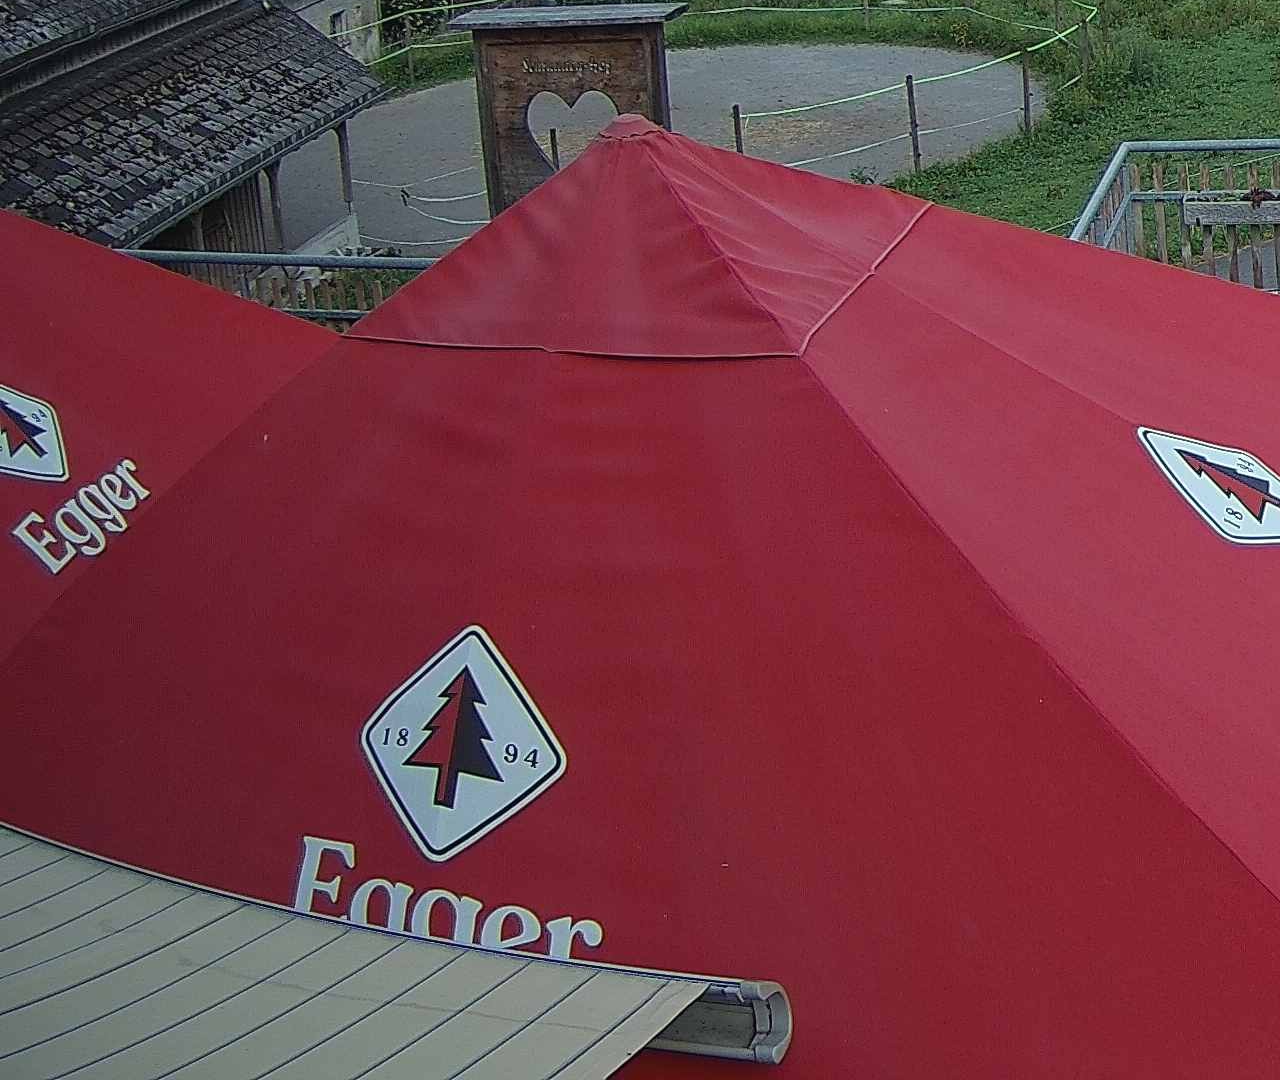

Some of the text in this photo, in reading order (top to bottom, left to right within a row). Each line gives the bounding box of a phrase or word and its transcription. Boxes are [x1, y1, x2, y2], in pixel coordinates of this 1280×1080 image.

[11, 459, 151, 574] Egger
[382, 727, 539, 769] 18 94
